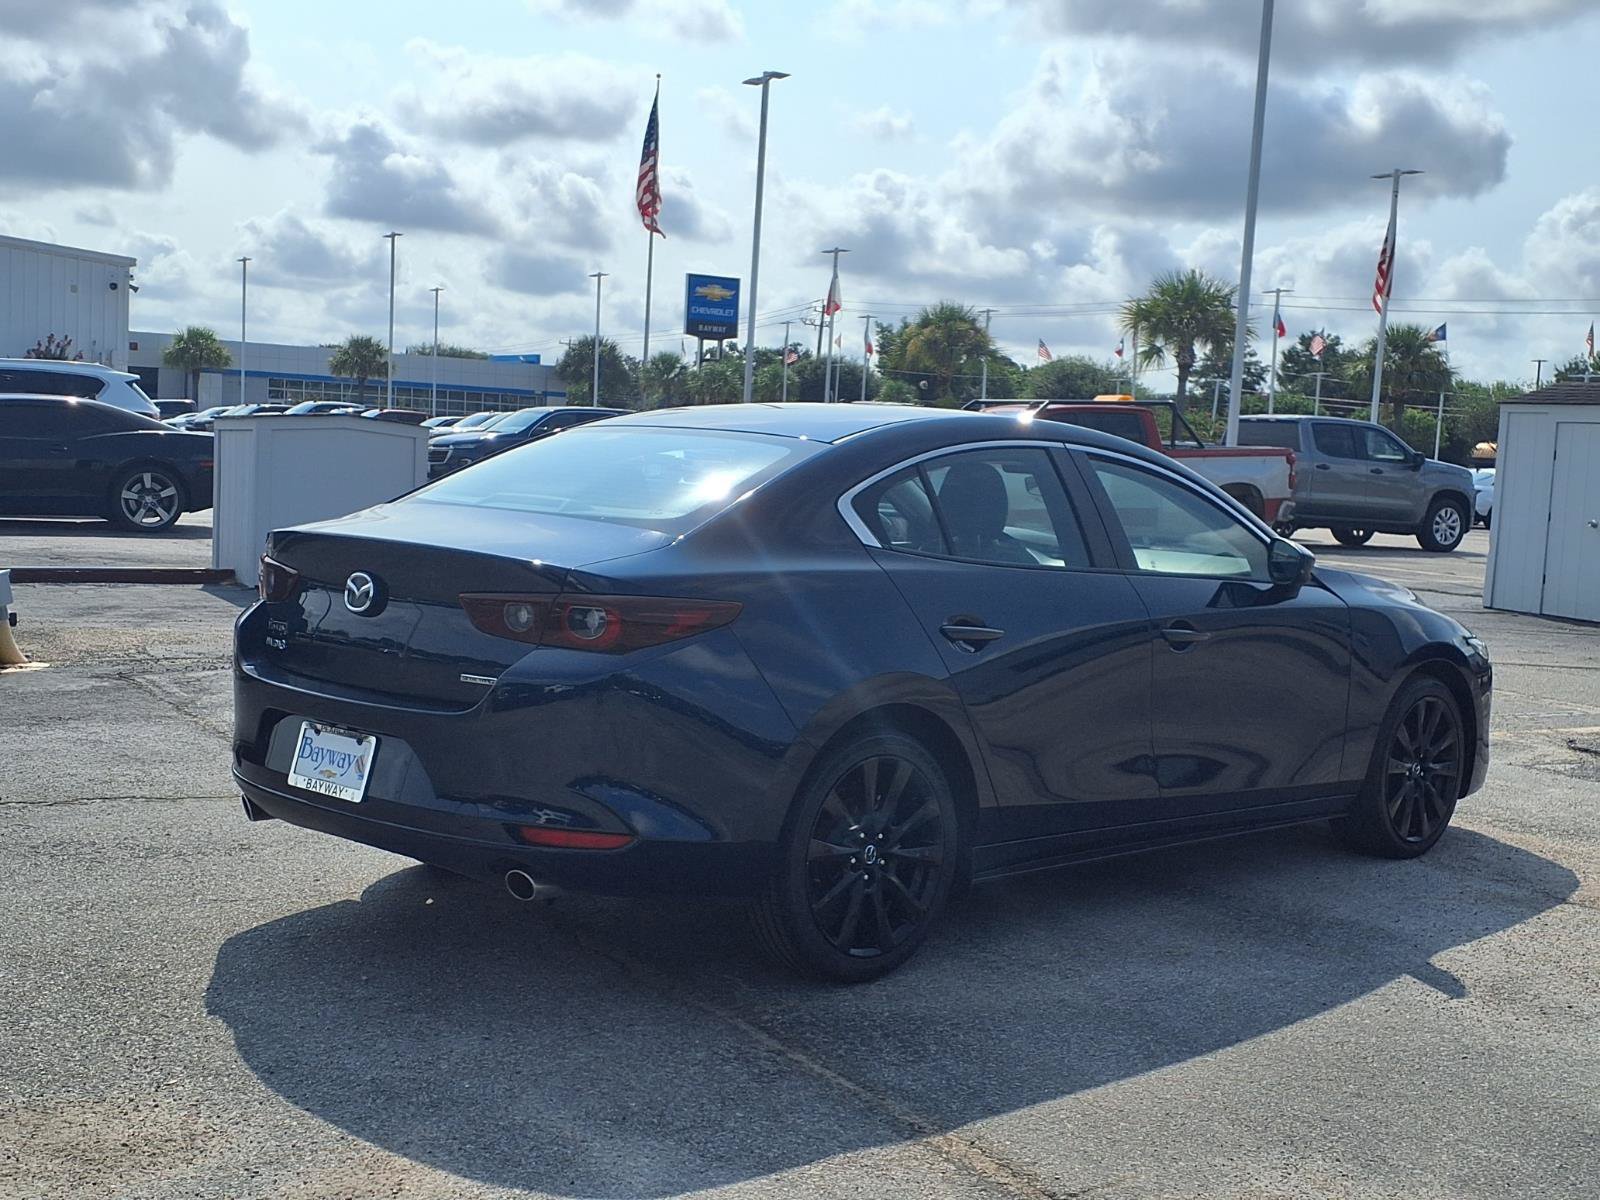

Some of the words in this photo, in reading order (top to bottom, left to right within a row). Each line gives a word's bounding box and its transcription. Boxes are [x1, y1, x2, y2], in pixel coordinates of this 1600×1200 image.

[691, 306, 734, 317] CHEVROLET
[698, 323, 727, 333] BAYWAY
[300, 736, 356, 777] Bayway
[305, 778, 345, 796] BAYWAY
